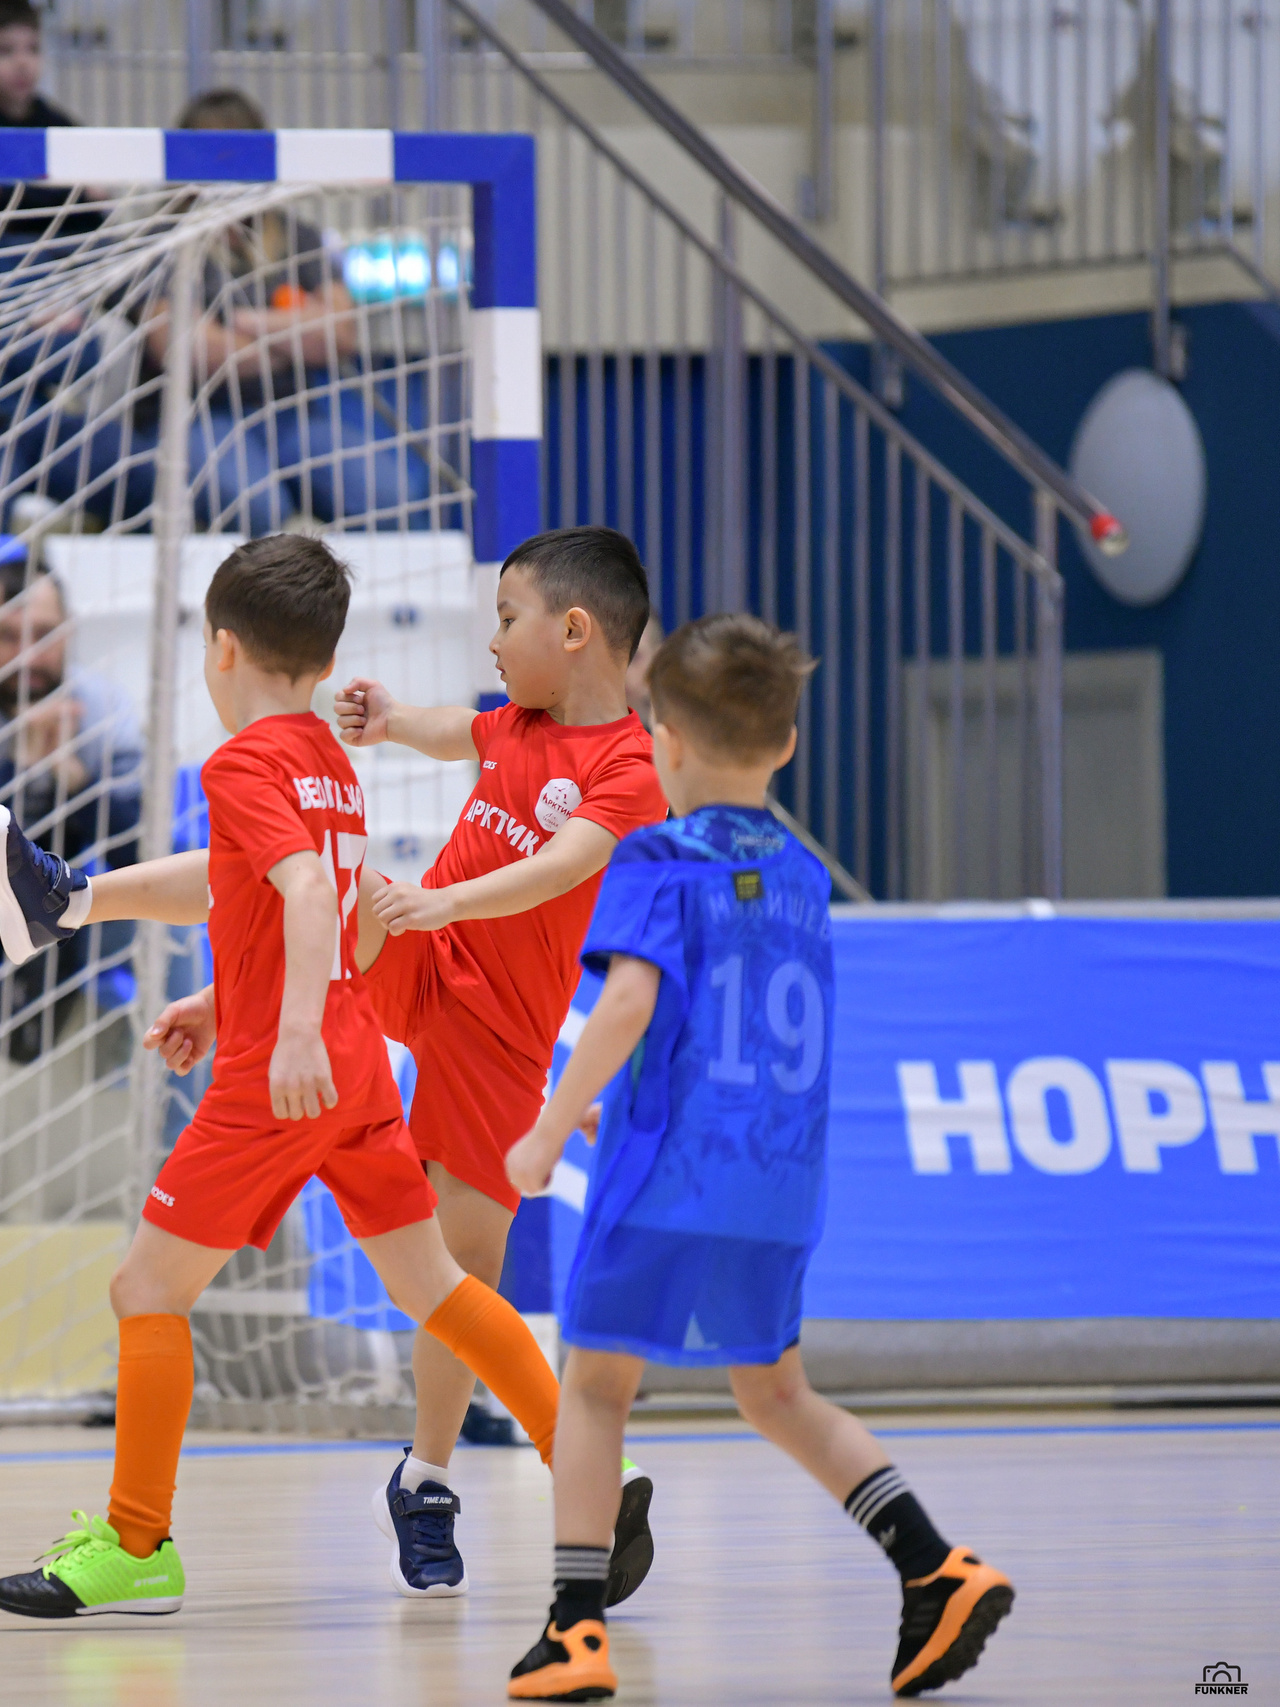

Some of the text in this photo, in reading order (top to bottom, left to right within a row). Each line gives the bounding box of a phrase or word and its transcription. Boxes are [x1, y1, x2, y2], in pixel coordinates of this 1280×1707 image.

[542, 792, 573, 817] АРКТИК
[319, 828, 368, 981] 17
[707, 954, 825, 1095] 19
[896, 1055, 1280, 1175] НОРН
[423, 1496, 453, 1505] TIME JUMP
